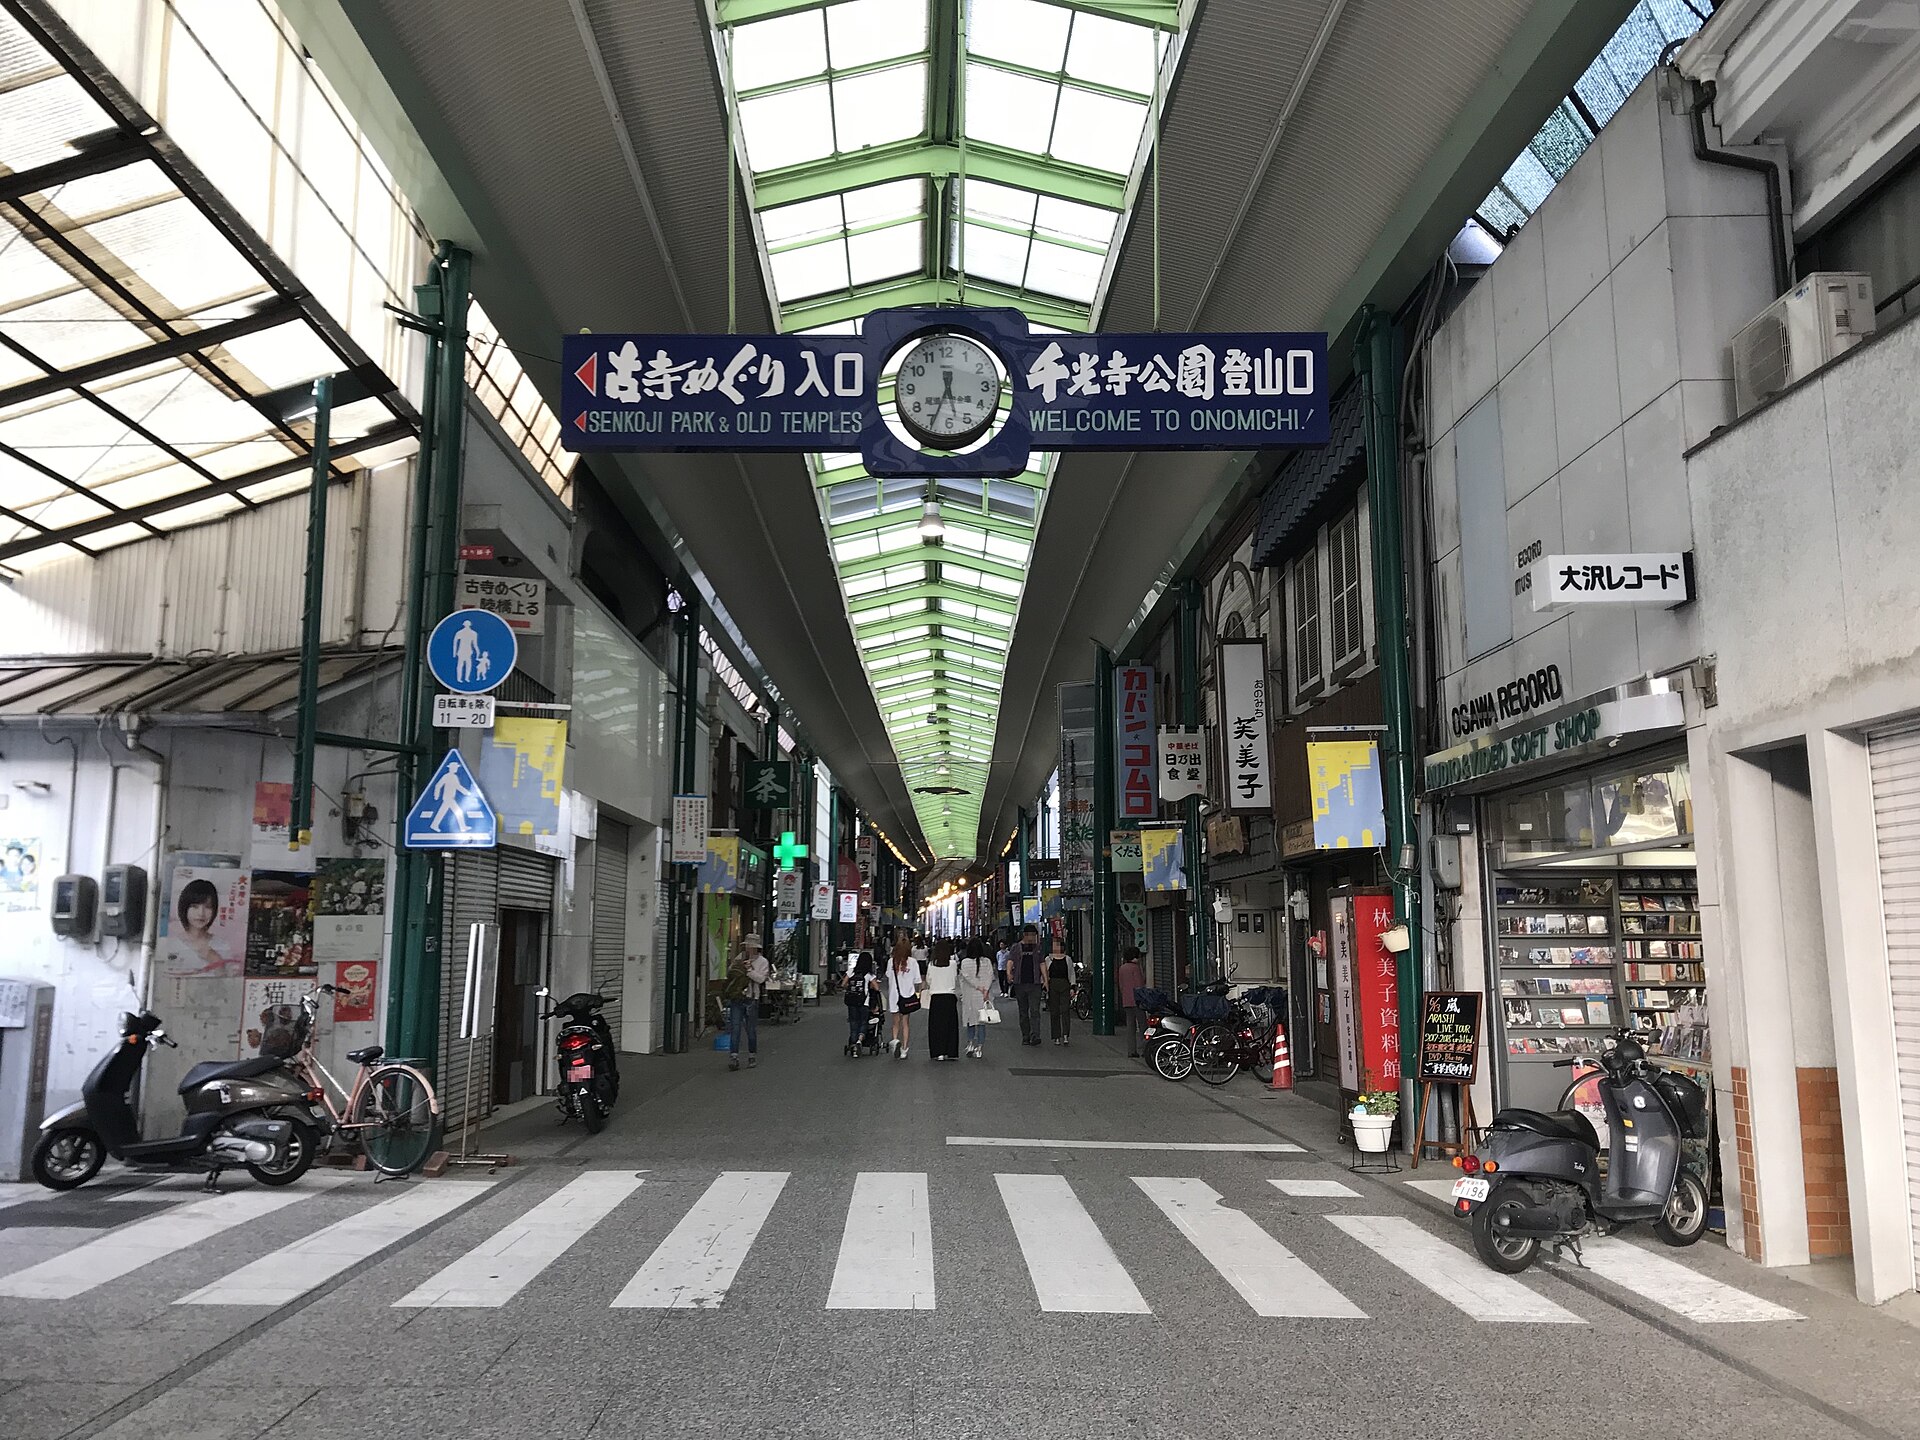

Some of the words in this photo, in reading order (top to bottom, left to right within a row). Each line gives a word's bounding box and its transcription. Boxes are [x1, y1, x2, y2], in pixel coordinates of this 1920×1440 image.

[605, 340, 785, 404] 古寺めぐり
[795, 350, 863, 397] 入口
[1026, 341, 1215, 403] 千光寺公園
[1221, 348, 1314, 396] 登山口
[906, 383, 916, 395] 9
[981, 380, 990, 393] 3
[588, 410, 663, 433] SENKOJI
[671, 411, 715, 433] PARK
[719, 416, 730, 432] &
[736, 411, 772, 433] OLD
[781, 411, 862, 433] TEMPLES
[1029, 410, 1141, 432] WELCOME
[1150, 410, 1180, 430] TO
[464, 579, 538, 598] 古寺めぐり
[1559, 564, 1680, 591] 大沢レコード
[1123, 667, 1148, 733] カバン
[1451, 692, 1499, 738] OSAWA
[1497, 664, 1562, 720] RECORD
[1167, 742, 1198, 750] 中華そば
[1511, 726, 1549, 764] SOFT
[1554, 708, 1600, 750] SHOP
[1233, 716, 1263, 800] 芙美子
[746, 767, 787, 803] 茶
[263, 981, 286, 1004] 猫
[1444, 997, 1461, 1013] 嵐
[1426, 1013, 1456, 1023] ARASHI
[1436, 1024, 1454, 1033] LIVE
[1455, 1024, 1471, 1033] TOUR
[1460, 1187, 1485, 1198] 1196
